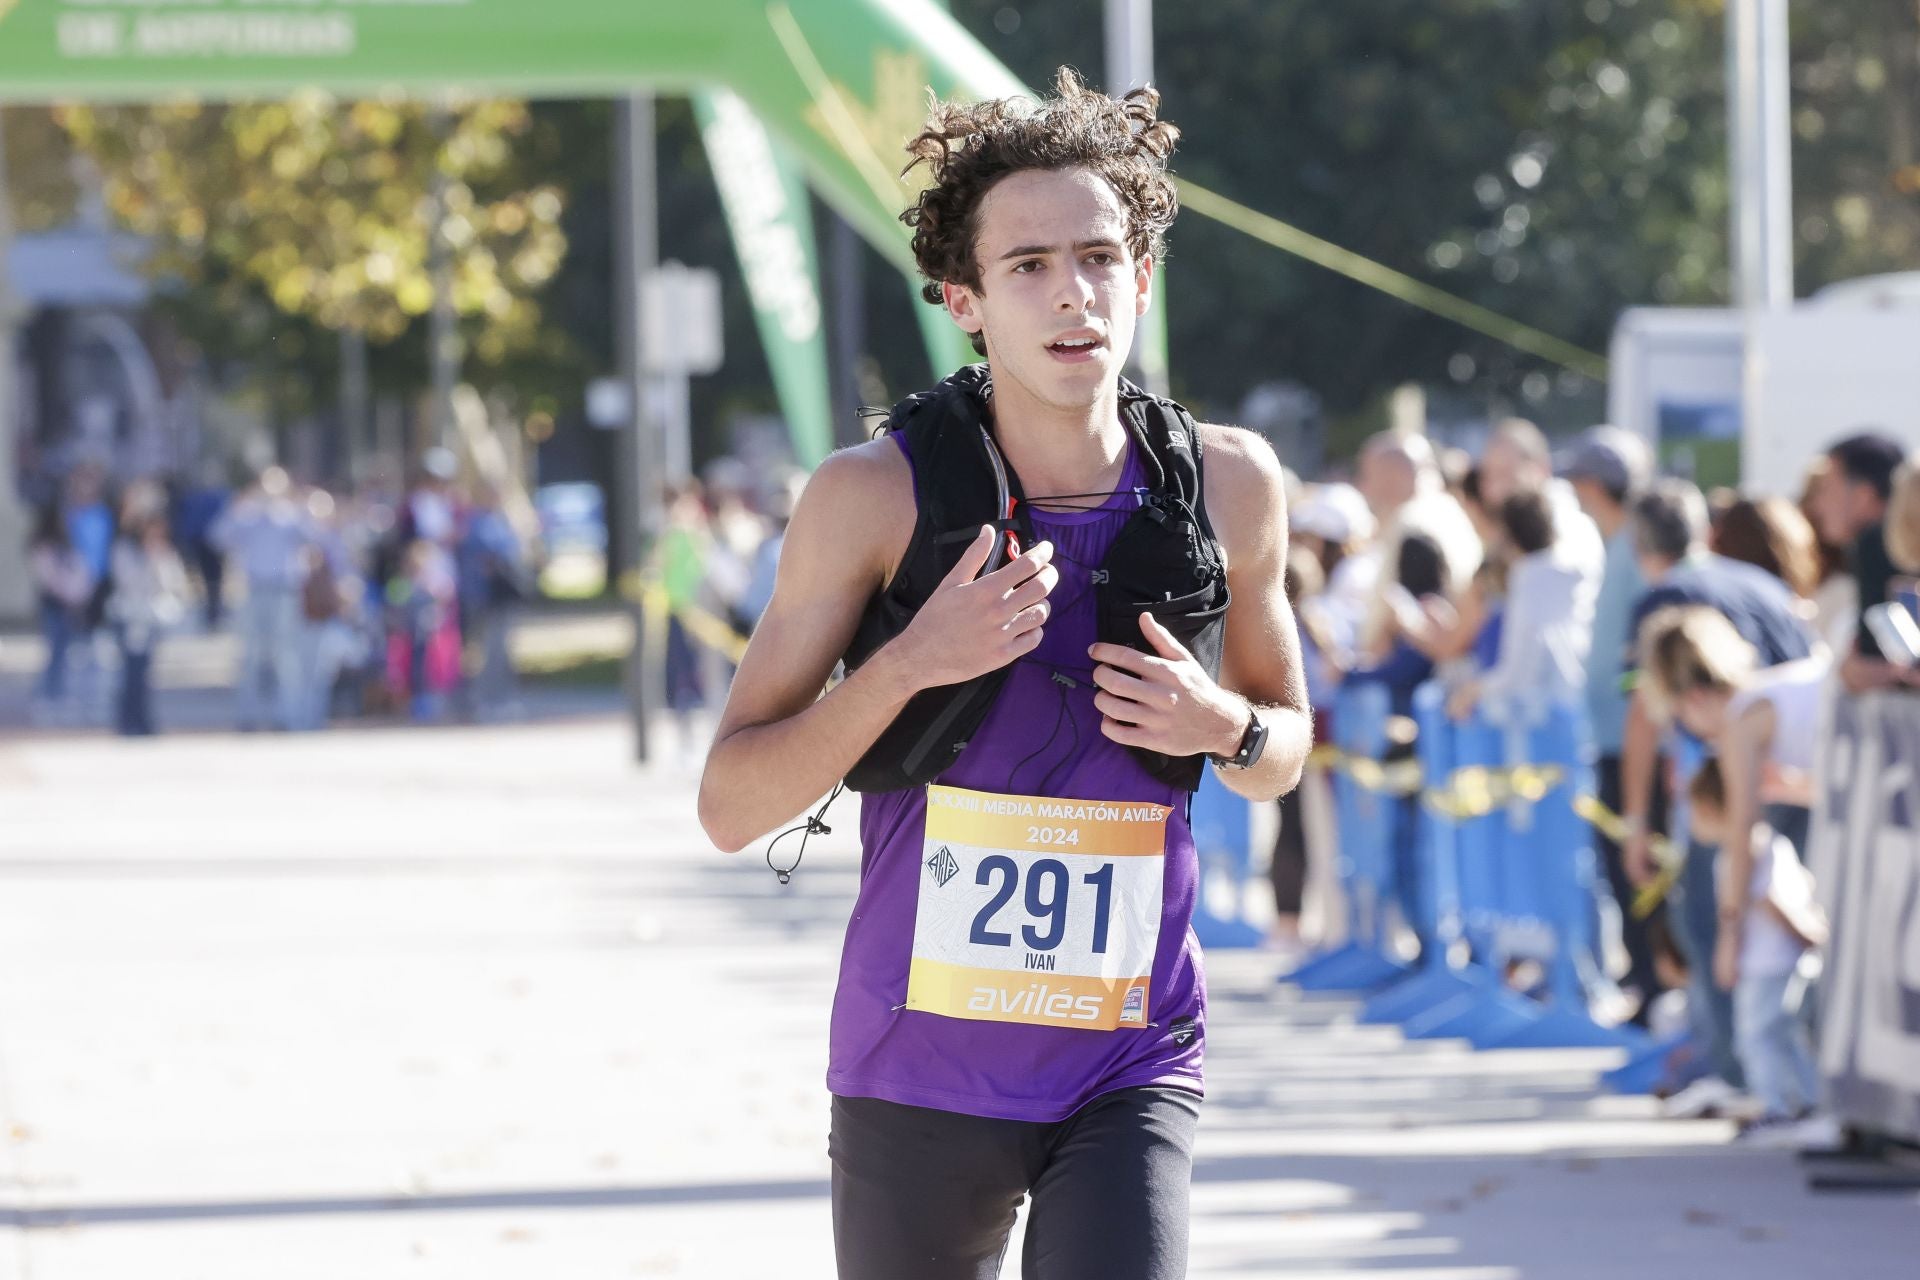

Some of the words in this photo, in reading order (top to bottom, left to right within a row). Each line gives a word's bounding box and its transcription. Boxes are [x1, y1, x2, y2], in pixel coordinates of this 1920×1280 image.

[983, 799, 1034, 817] MEDIA
[1037, 802, 1120, 822] MARATÓN
[1121, 805, 1165, 823] AVILÉS
[1026, 826, 1080, 846] 2024
[969, 855, 1114, 954] 291
[1024, 952, 1056, 971] IVAN
[967, 983, 1104, 1020] avilés
